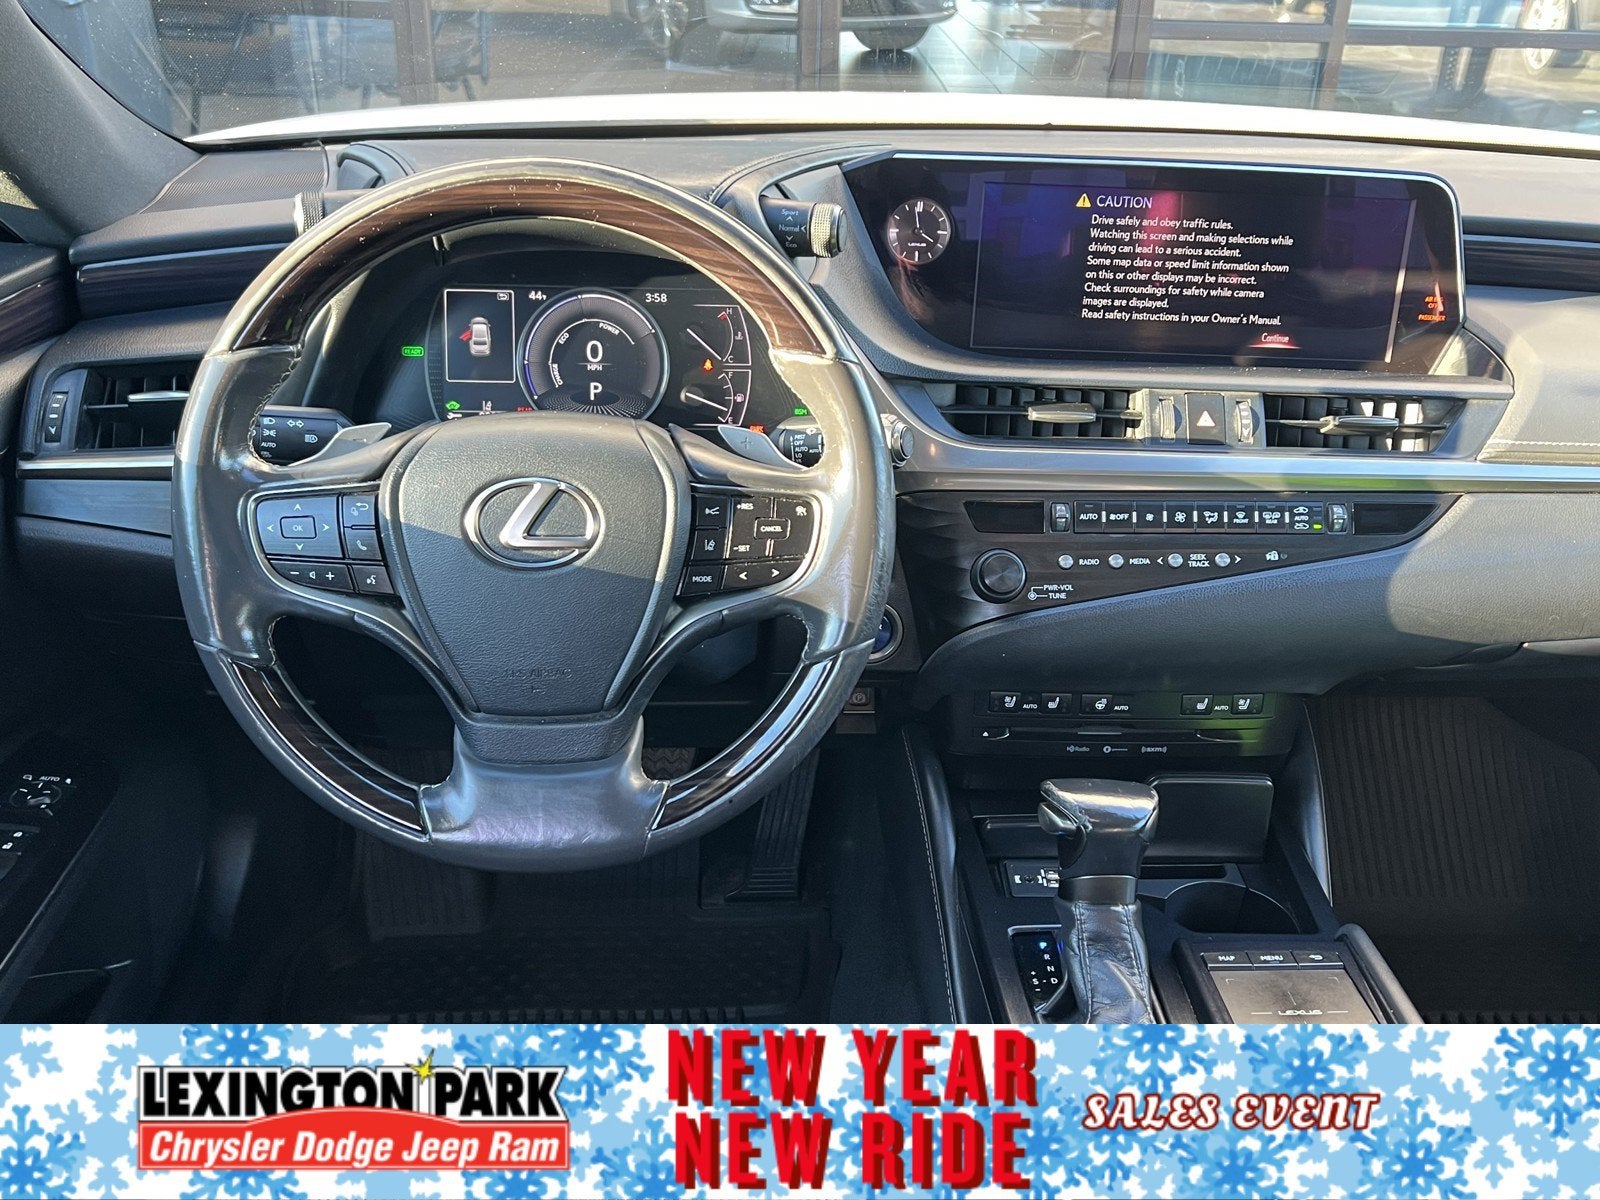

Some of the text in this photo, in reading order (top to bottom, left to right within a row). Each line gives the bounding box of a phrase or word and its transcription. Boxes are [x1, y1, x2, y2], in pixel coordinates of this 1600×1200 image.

[1096, 195, 1153, 208] CAUTION
[781, 208, 799, 216] Sport
[779, 224, 800, 232] Normal
[1091, 214, 1234, 230] Drive safely and obey traffic rules.
[1090, 228, 1294, 246] Watching this screen and making selections while
[1088, 242, 1117, 254] driving
[1118, 246, 1133, 254] can
[1135, 244, 1153, 254] lead
[1155, 246, 1164, 254] to
[1173, 246, 1203, 256] serious
[1204, 247, 1242, 257] accident.
[1087, 255, 1289, 272] Some map data or speed limit information shown
[1085, 269, 1257, 285] on this or other displays may be incorrect.
[1084, 282, 1265, 298] Check surroundings for safety while camera
[645, 293, 668, 303] 3:58
[1082, 296, 1112, 307] images
[1128, 297, 1169, 309] displayed.
[1081, 309, 1282, 325] Read safety instructions in your Owner's Manual.
[599, 322, 620, 336] POWER
[558, 332, 570, 345] ECO
[1261, 332, 1290, 343] Continue
[586, 340, 603, 363] 0
[727, 355, 734, 363] C
[728, 371, 733, 379] F
[589, 382, 603, 401] P
[727, 417, 733, 425] E
